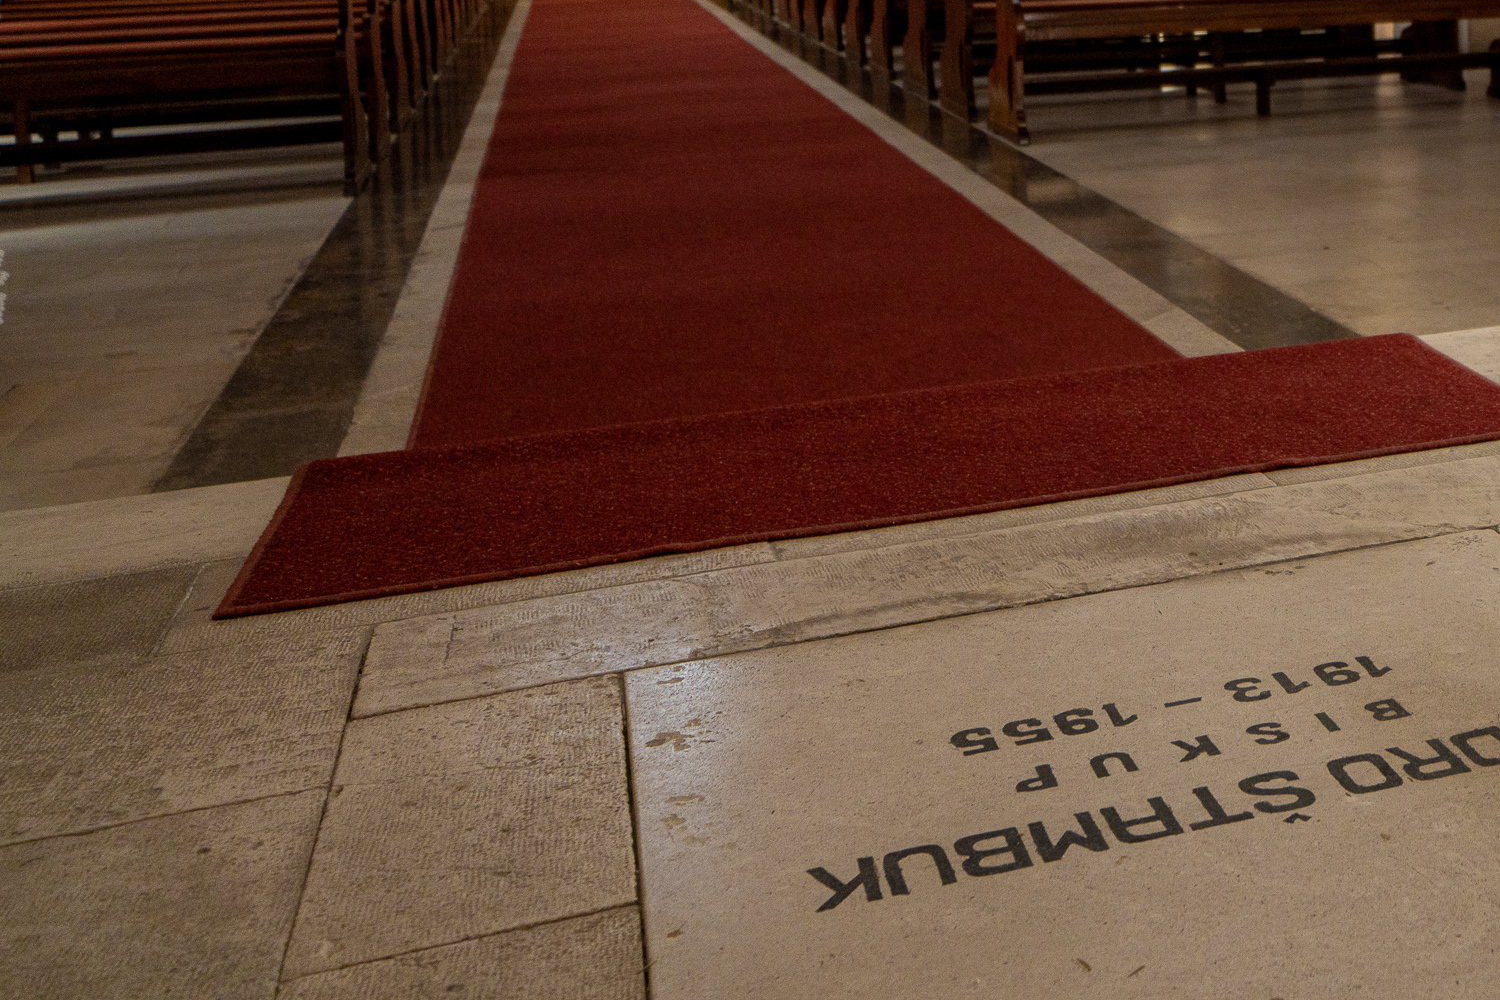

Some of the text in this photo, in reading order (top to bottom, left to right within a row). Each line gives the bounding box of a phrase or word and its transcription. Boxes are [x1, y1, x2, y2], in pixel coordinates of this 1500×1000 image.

[1223, 655, 1393, 703] 1913
[948, 702, 1139, 757] 1955
[1015, 697, 1412, 793] BISKUP
[805, 770, 1317, 914] ŠTAMBUK
